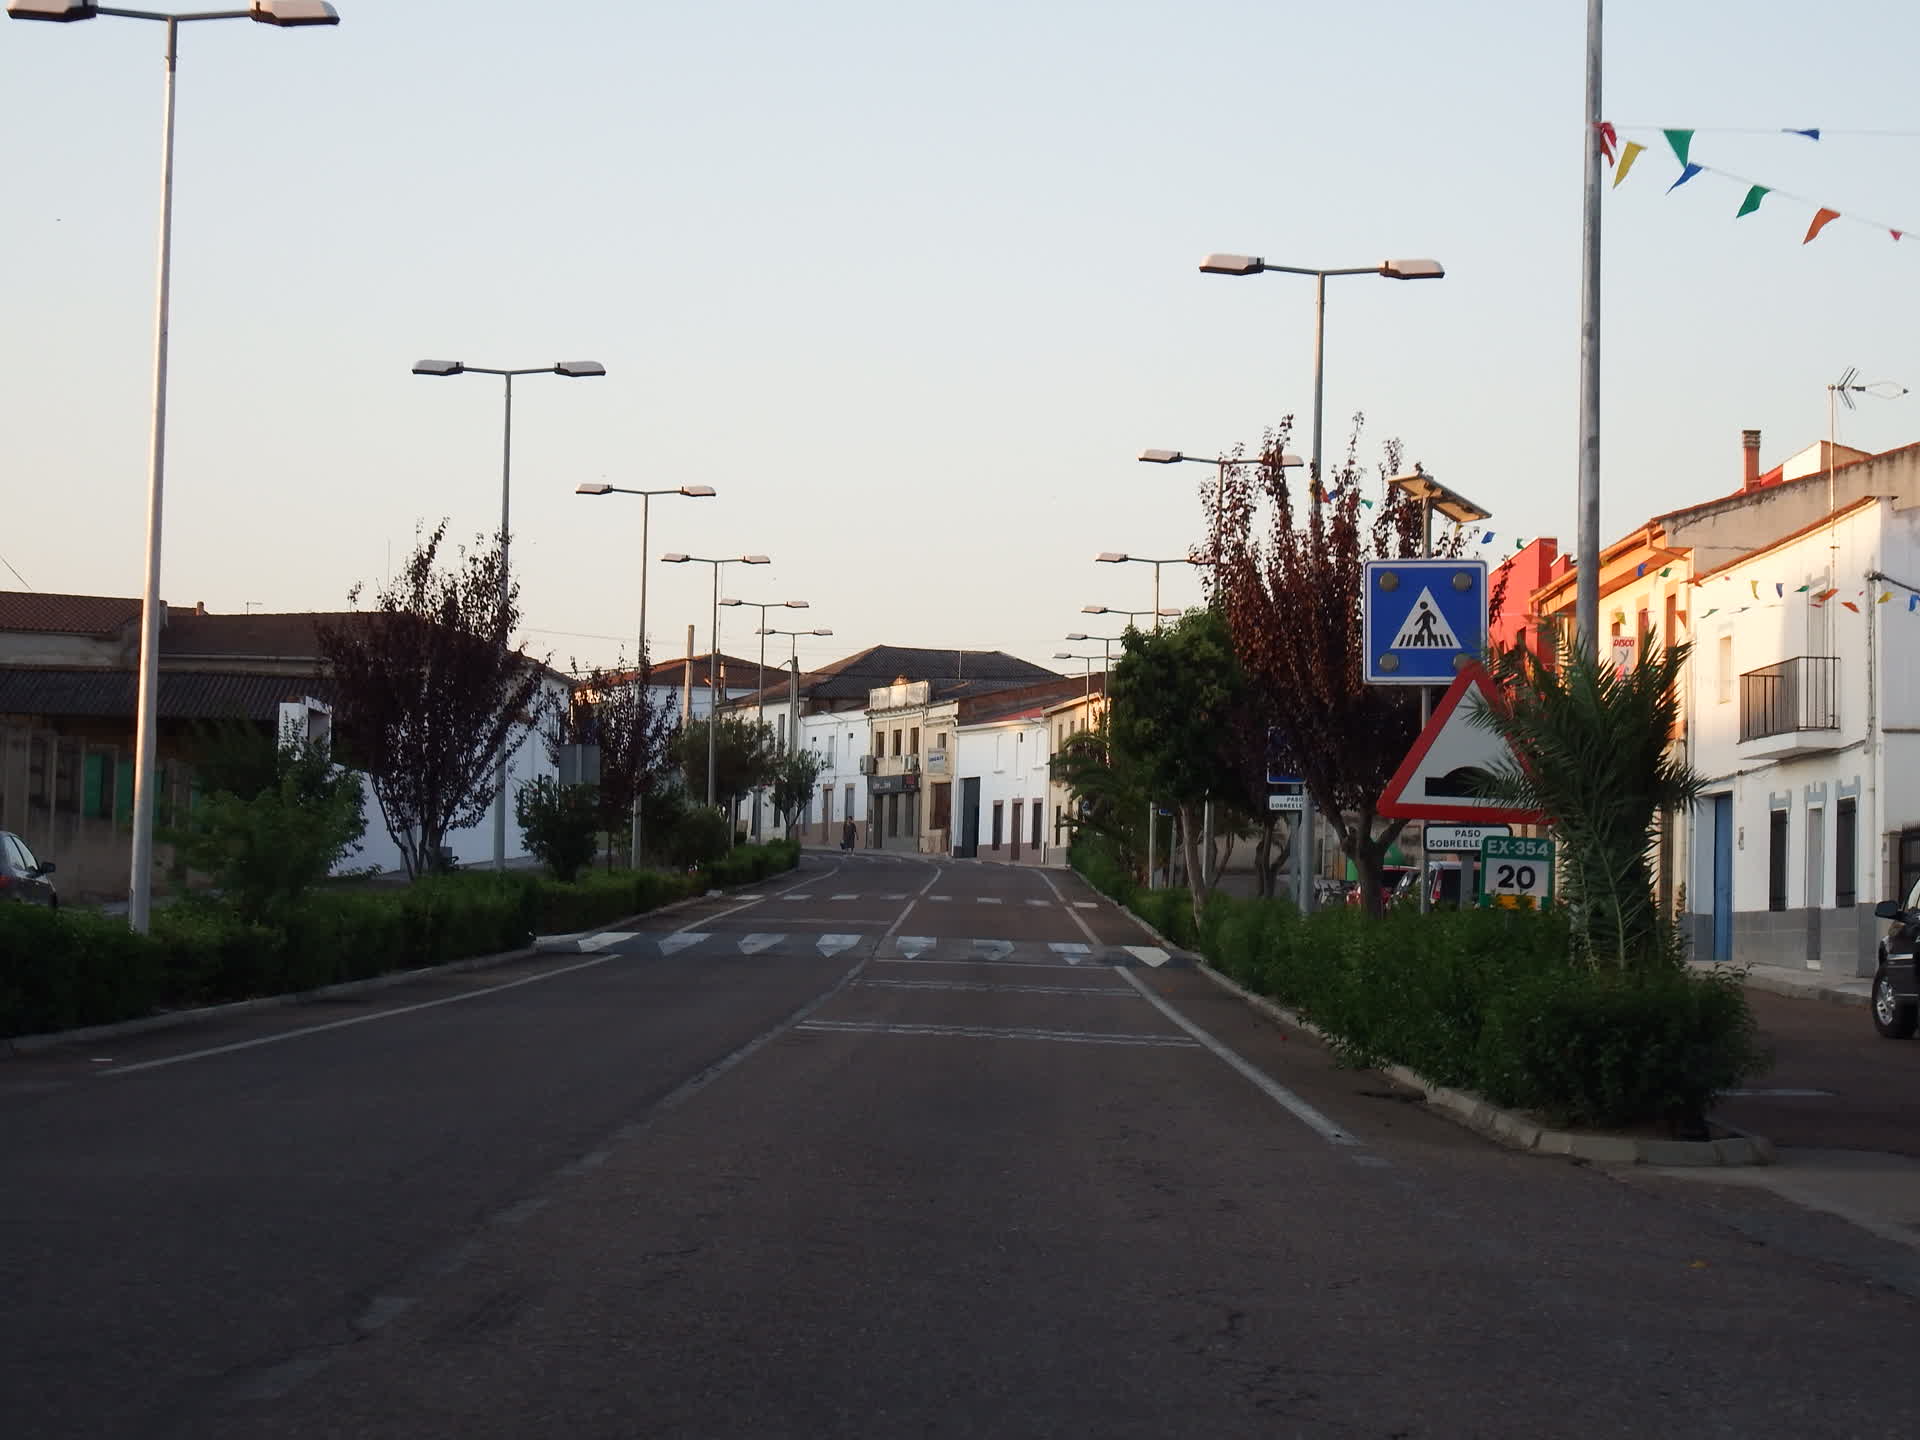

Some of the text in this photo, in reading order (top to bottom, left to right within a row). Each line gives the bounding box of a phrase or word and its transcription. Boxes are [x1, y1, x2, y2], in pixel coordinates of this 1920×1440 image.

[1613, 639, 1635, 647] DISCO
[1454, 829, 1481, 838] PASO
[1429, 840, 1481, 848] SOBREELE
[1487, 840, 1549, 856] EX-354
[1497, 864, 1536, 889] 20
